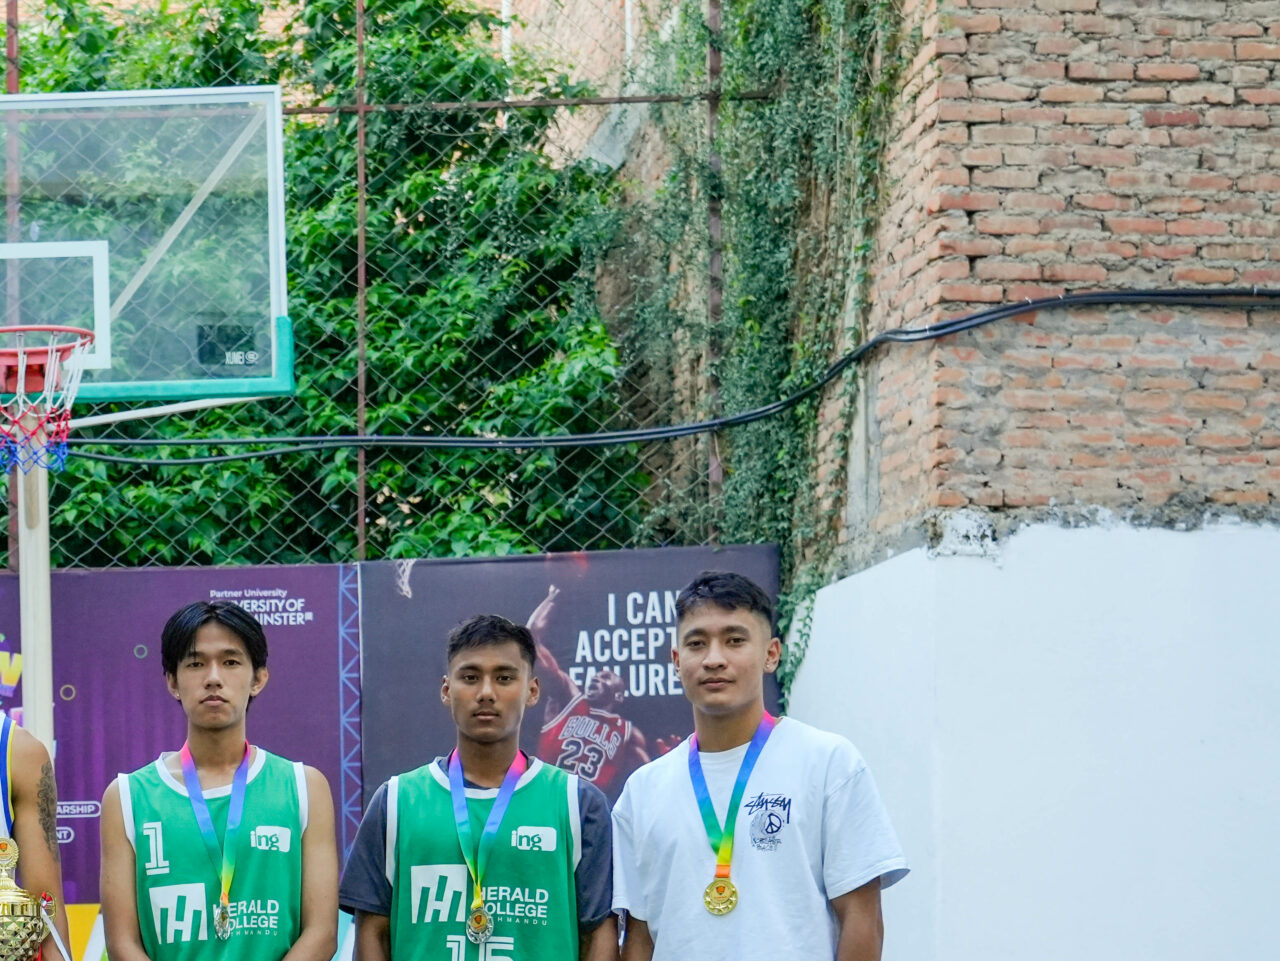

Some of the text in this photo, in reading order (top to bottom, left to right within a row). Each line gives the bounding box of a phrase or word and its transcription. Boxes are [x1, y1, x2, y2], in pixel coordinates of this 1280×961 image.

[209, 587, 288, 598] Partner University
[285, 599, 305, 611] OF
[608, 593, 616, 625] I
[575, 627, 677, 663] ACCEPT
[569, 663, 685, 698] FAURE
[558, 715, 621, 760] BULLS
[556, 738, 606, 781] 23
[56, 804, 95, 814] ARSHIP
[143, 821, 169, 876] 1
[485, 902, 548, 918] OLLEGE
[497, 917, 548, 926] HMANDU
[229, 916, 279, 930] OLLEGE
